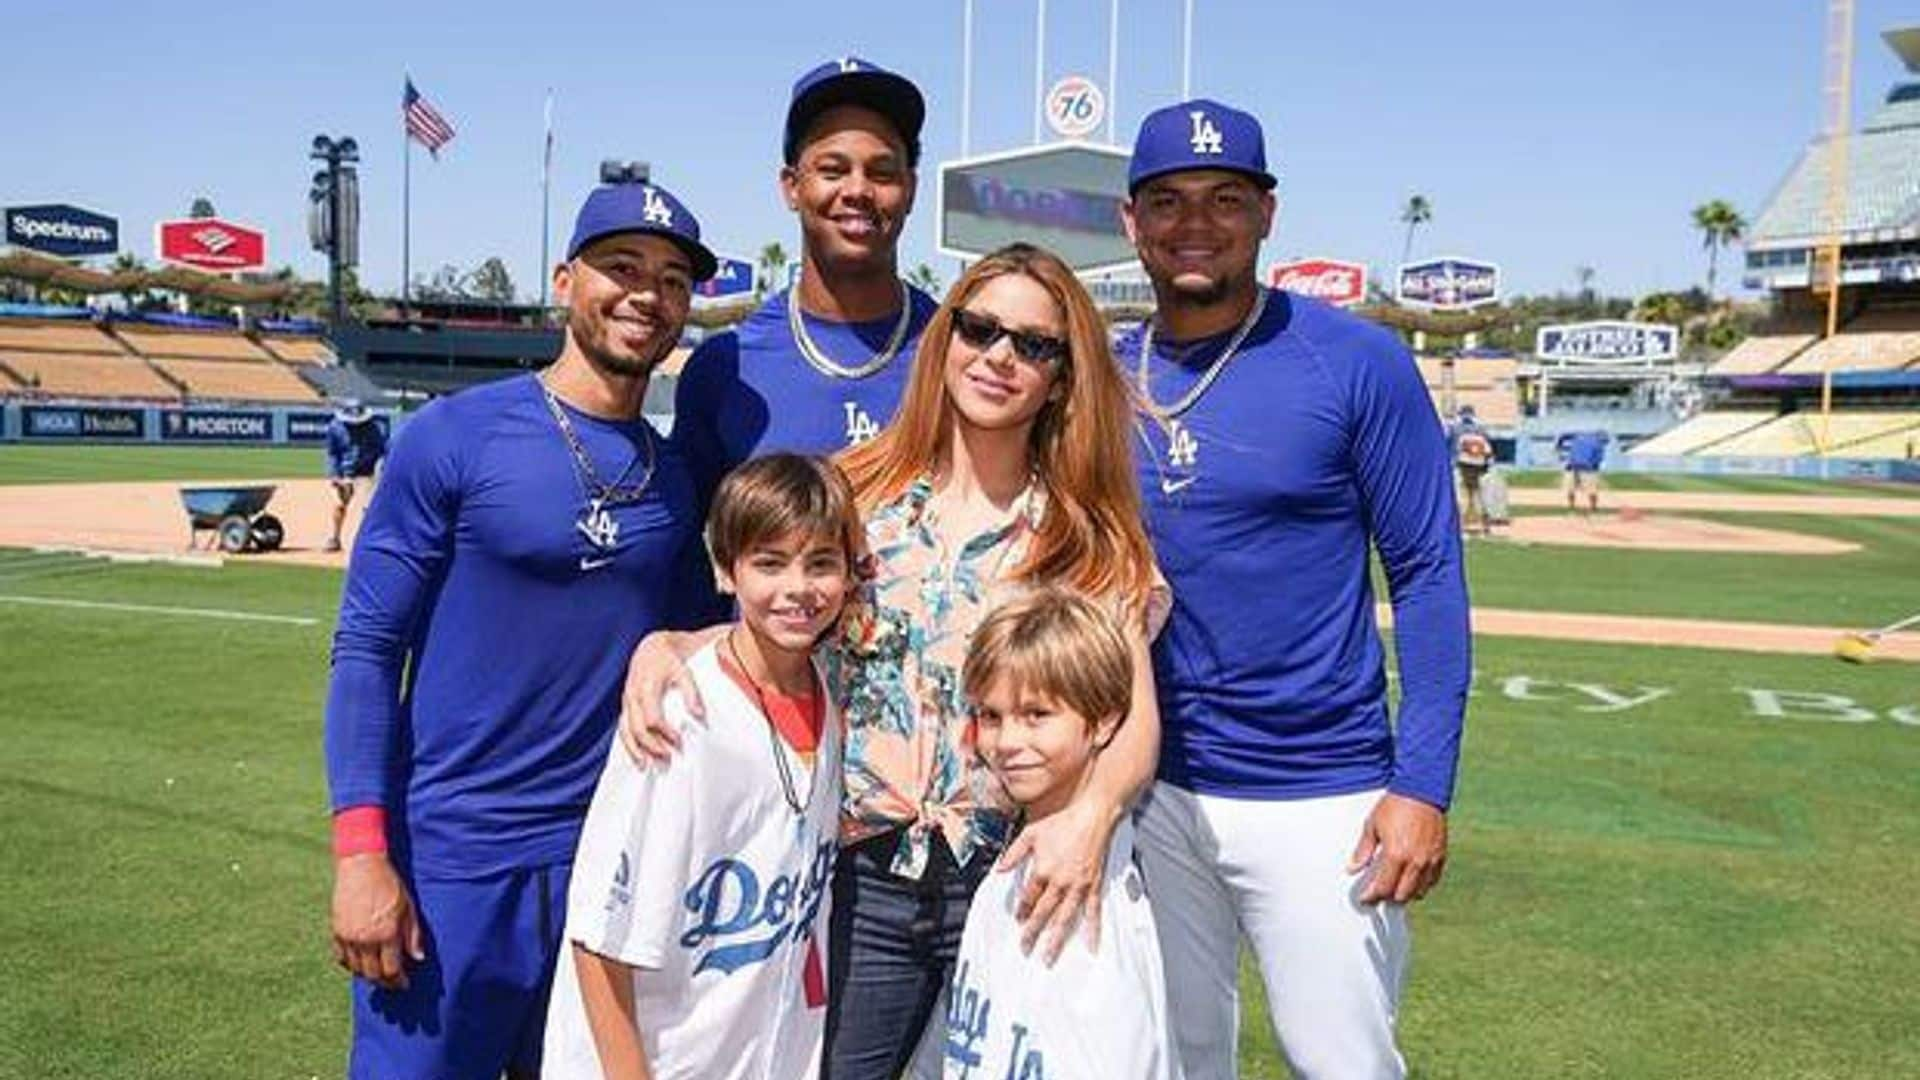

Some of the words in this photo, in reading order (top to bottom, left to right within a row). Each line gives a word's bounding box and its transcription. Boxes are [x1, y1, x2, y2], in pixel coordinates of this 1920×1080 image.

[1059, 92, 1092, 121] 76
[1190, 111, 1223, 154] LA
[12, 214, 108, 242] Spectrum
[642, 186, 673, 228] LA
[187, 417, 265, 435] MORTON
[844, 401, 879, 447] LA
[1167, 420, 1199, 465] LA
[577, 499, 619, 548] LA
